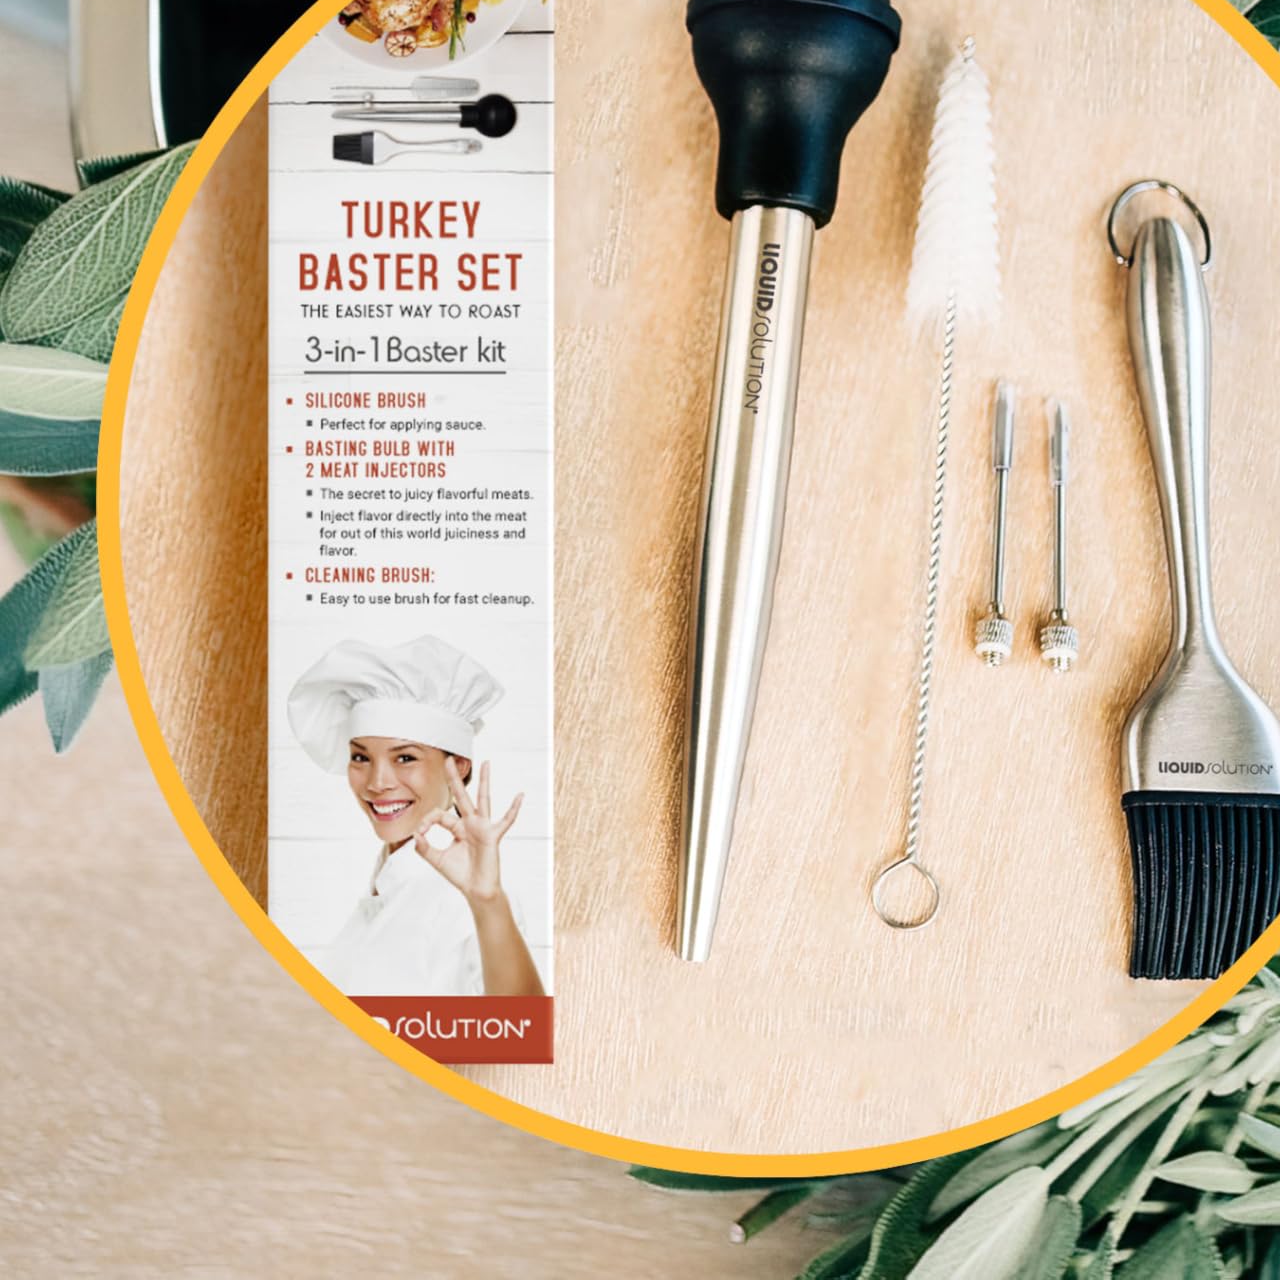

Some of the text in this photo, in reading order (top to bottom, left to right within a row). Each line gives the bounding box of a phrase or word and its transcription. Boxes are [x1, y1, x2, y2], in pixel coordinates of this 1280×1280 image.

[340, 199, 481, 240] TURKEY
[298, 251, 524, 293] BASTER SET
[300, 303, 521, 320] THE EASIEST WAY TO ROAST
[477, 335, 507, 363] kit
[305, 391, 427, 409] SILICONE BRUSH
[320, 417, 486, 433] Perfect for applying sauce.
[304, 439, 455, 457] BASTING BULB WITH
[305, 461, 447, 479] 2 MEAT INJECTORS
[320, 487, 534, 502] The secret to juicy flavorful meats.
[320, 509, 527, 525] Inject flavor directly into the meat
[319, 526, 526, 542] for out of this world juiciness and
[319, 544, 357, 557] flavor.
[304, 566, 435, 584] CLEANING BRUSH:
[320, 591, 535, 608] Easy to use brush for fast cleanup.
